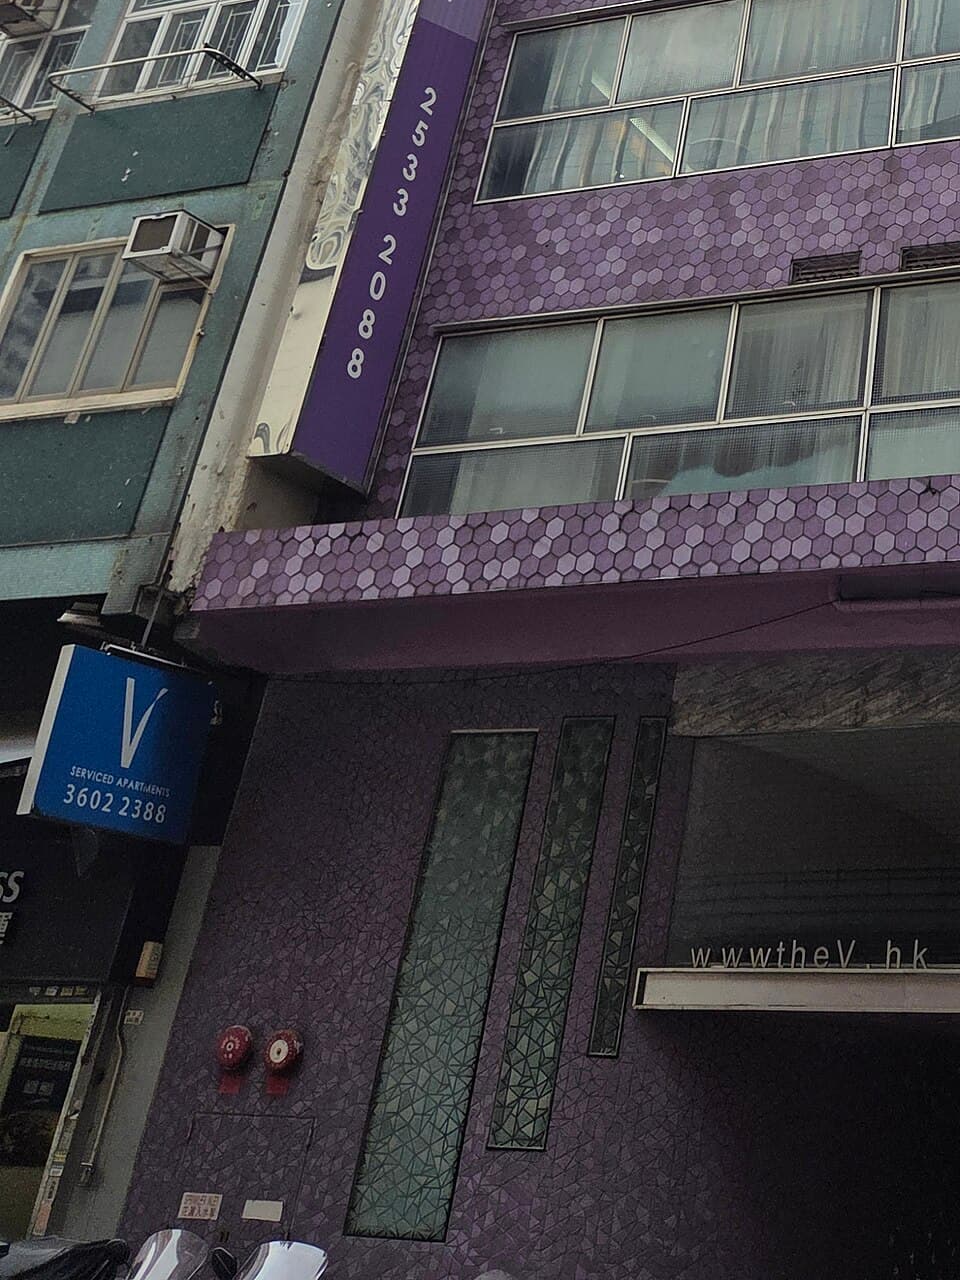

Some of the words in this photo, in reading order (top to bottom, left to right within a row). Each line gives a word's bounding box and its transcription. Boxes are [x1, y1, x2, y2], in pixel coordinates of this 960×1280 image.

[393, 86, 437, 216] 2533
[347, 234, 397, 379] 2088
[121, 677, 169, 769] V
[63, 783, 114, 813] 3602
[118, 796, 167, 824] 2388
[70, 765, 114, 785] SERVICED
[115, 778, 171, 798] APARTMENTS
